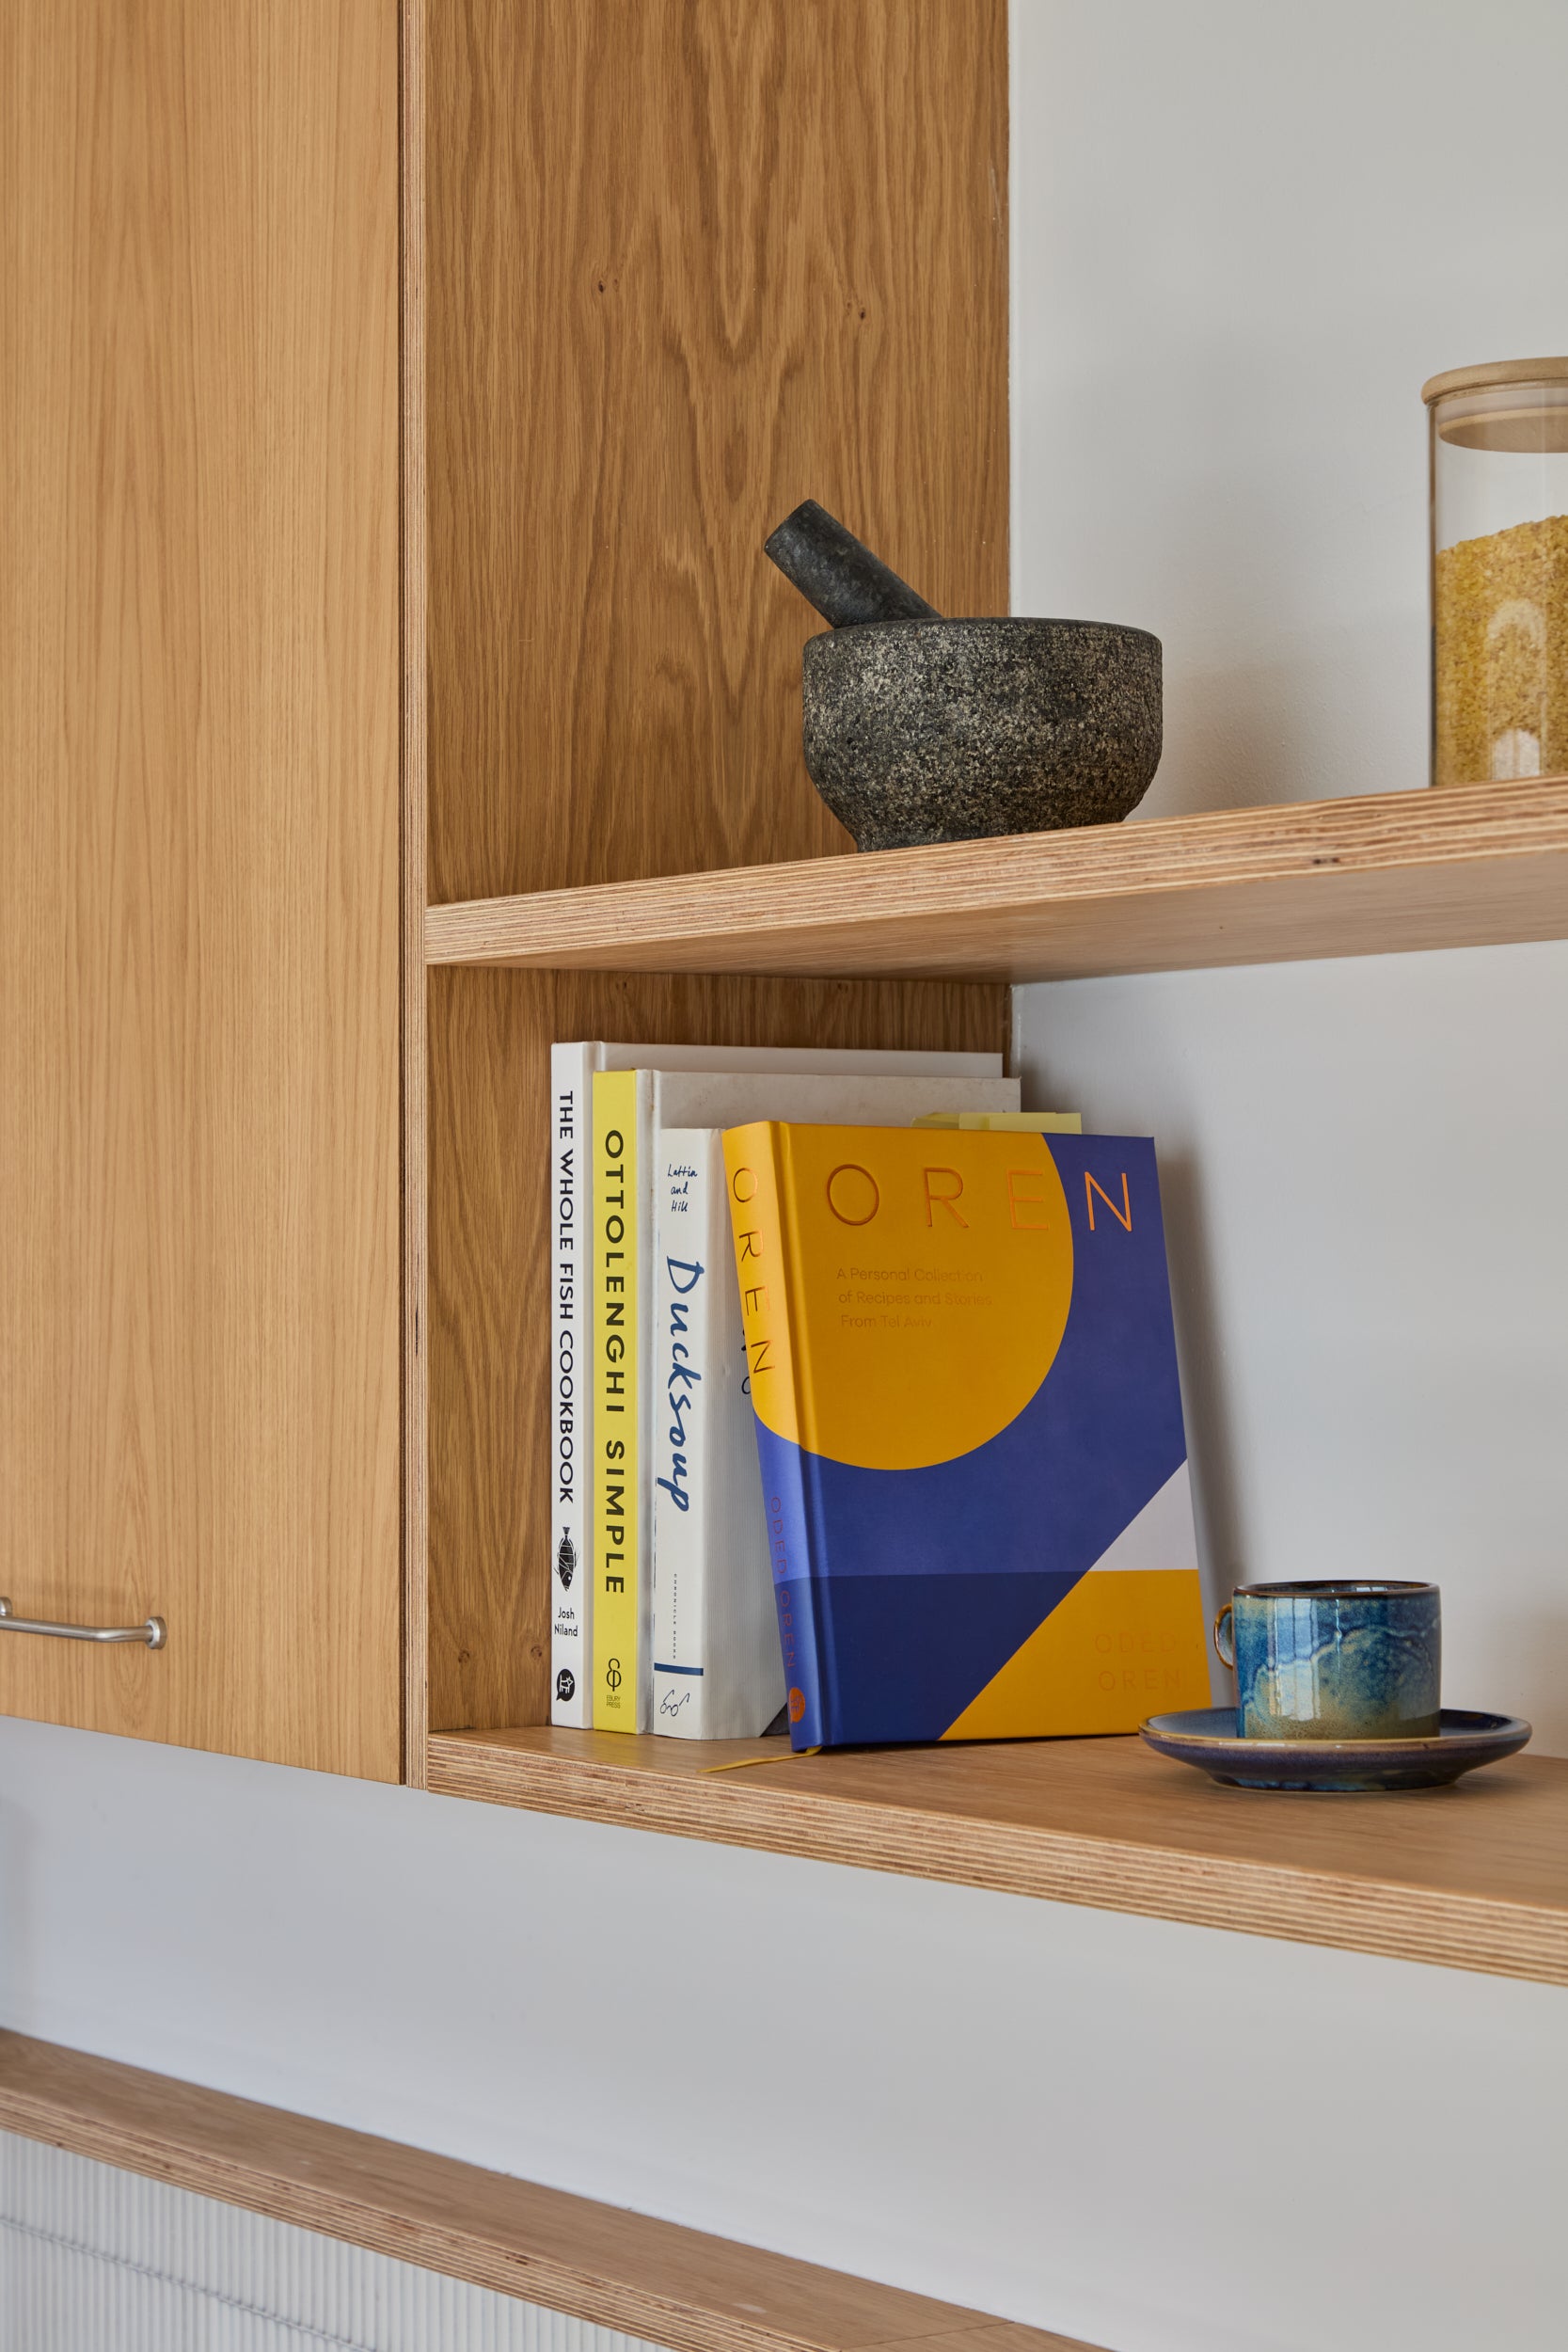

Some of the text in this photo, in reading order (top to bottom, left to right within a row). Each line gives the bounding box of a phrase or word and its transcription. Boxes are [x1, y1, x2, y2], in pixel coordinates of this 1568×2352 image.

[667, 1163, 698, 1177] Lattin
[670, 1181, 689, 1195] and
[826, 1163, 1132, 1232] OREN
[671, 1200, 689, 1212] Hill
[732, 1167, 776, 1375] OREN
[836, 1267, 984, 1282] A Personal Collection
[559, 1090, 574, 1503] THE WHOLE FISH COOKBOOK
[838, 1291, 993, 1306] of Recipes and Stories
[841, 1315, 932, 1328] From Tel Aviv
[605, 1129, 626, 1594] OTTOLENGHI SIMPLE
[657, 1255, 705, 1512] Ducksoup
[770, 1497, 797, 1667] ODED OREN
[558, 1606, 575, 1619] Josh
[554, 1624, 578, 1637] Niland
[1098, 1670, 1180, 1692] OREN
